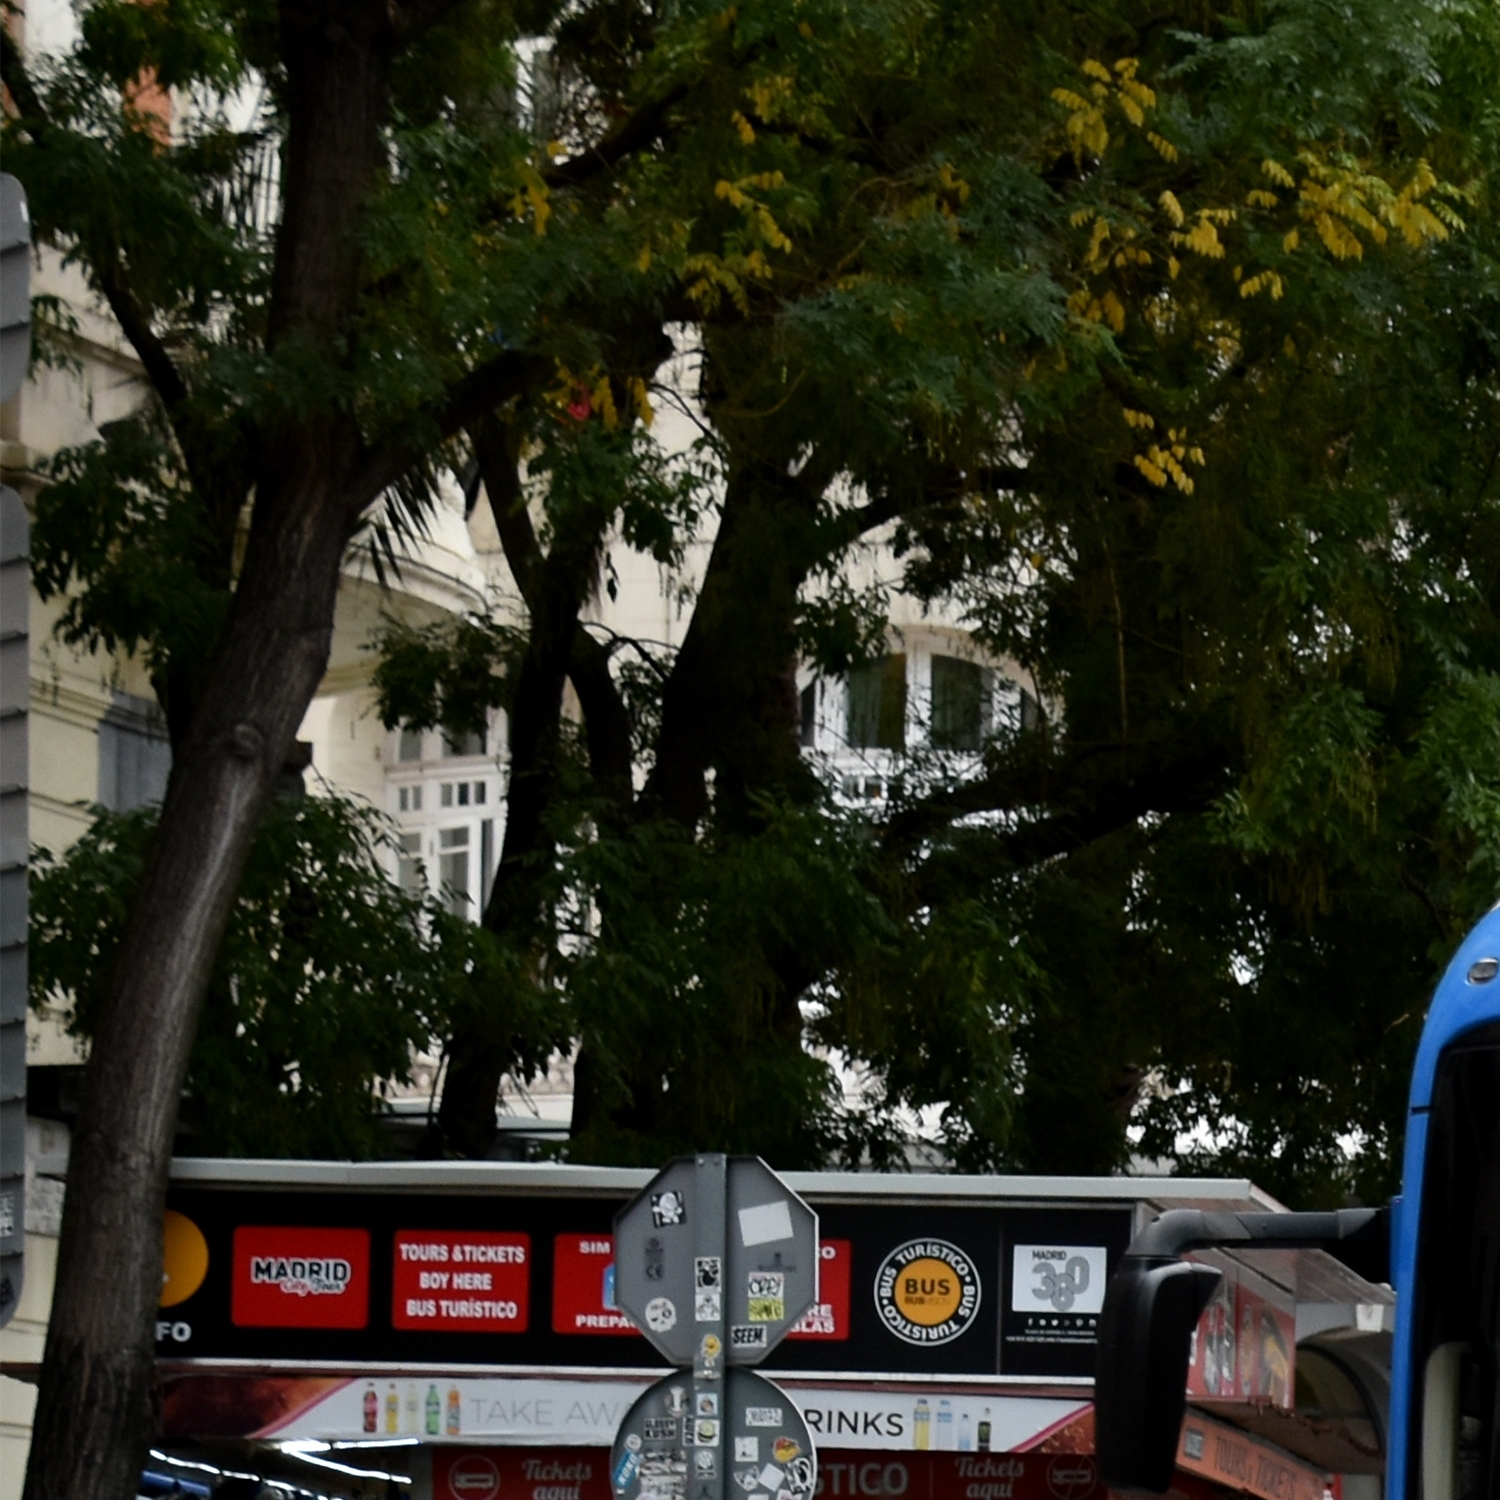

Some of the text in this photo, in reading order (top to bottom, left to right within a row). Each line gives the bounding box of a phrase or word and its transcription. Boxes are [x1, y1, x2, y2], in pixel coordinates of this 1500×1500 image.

[400, 1243, 448, 1262] TOURS
[579, 1241, 611, 1254] SIM
[1032, 1250, 1067, 1261] MADRID
[252, 1257, 350, 1283] MADRID
[452, 1273, 492, 1290] HERE
[879, 1266, 898, 1297] BUS
[905, 1278, 950, 1296] BUS
[406, 1297, 518, 1318] BUS TURÍSTICO
[575, 1314, 640, 1328] PREPA
[154, 1321, 192, 1343] FO
[471, 1398, 633, 1426] TAKE AW
[804, 1408, 905, 1437] RINKS
[521, 1458, 592, 1483] Tickets
[954, 1456, 1024, 1479] Tickets
